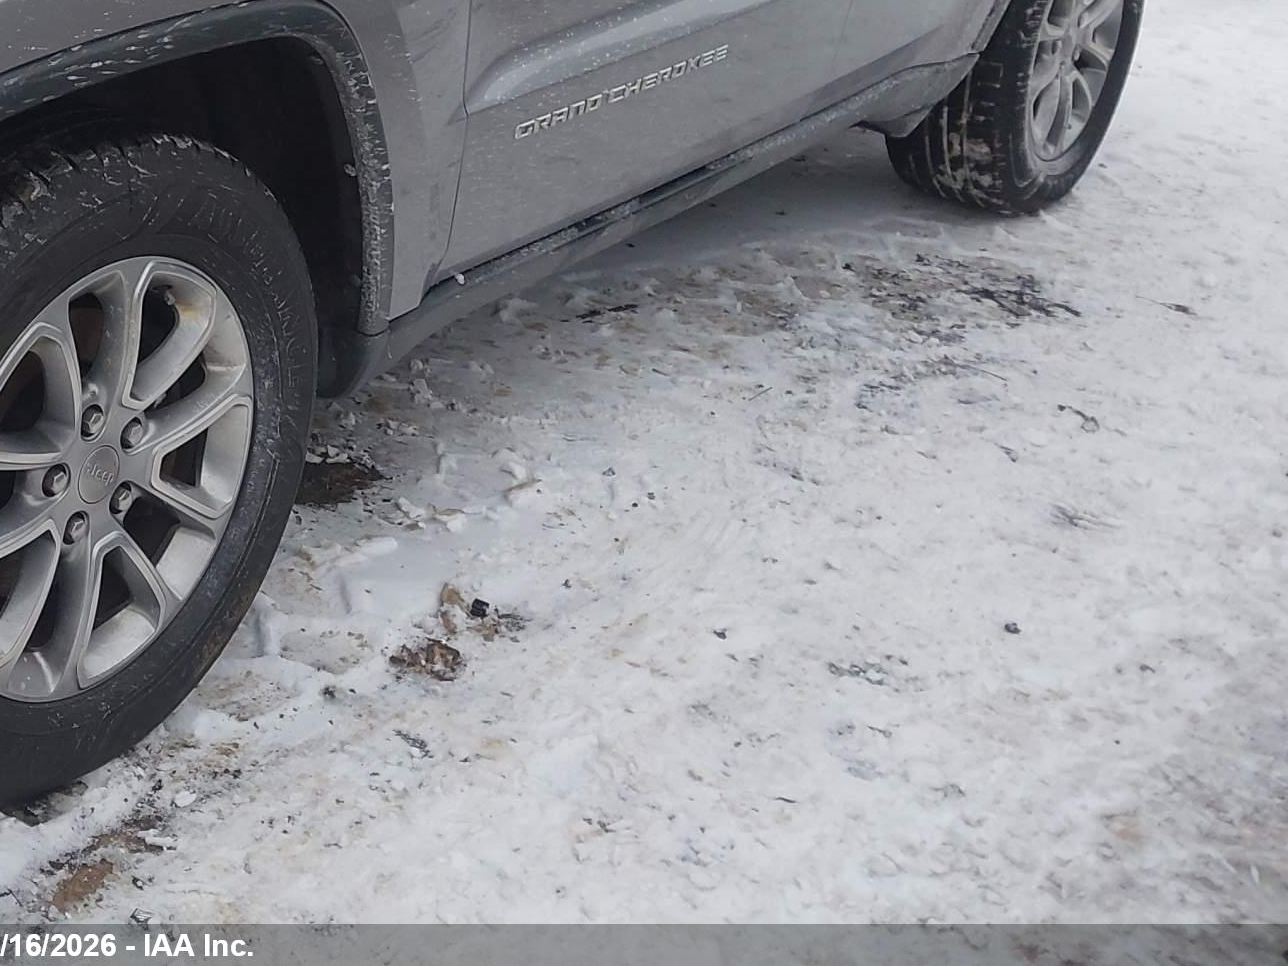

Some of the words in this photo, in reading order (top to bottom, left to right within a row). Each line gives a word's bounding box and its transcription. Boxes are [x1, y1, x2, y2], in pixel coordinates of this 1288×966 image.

[515, 94, 603, 139] GRAND
[607, 44, 729, 103] CHEROKEE
[87, 464, 114, 486] Jeep
